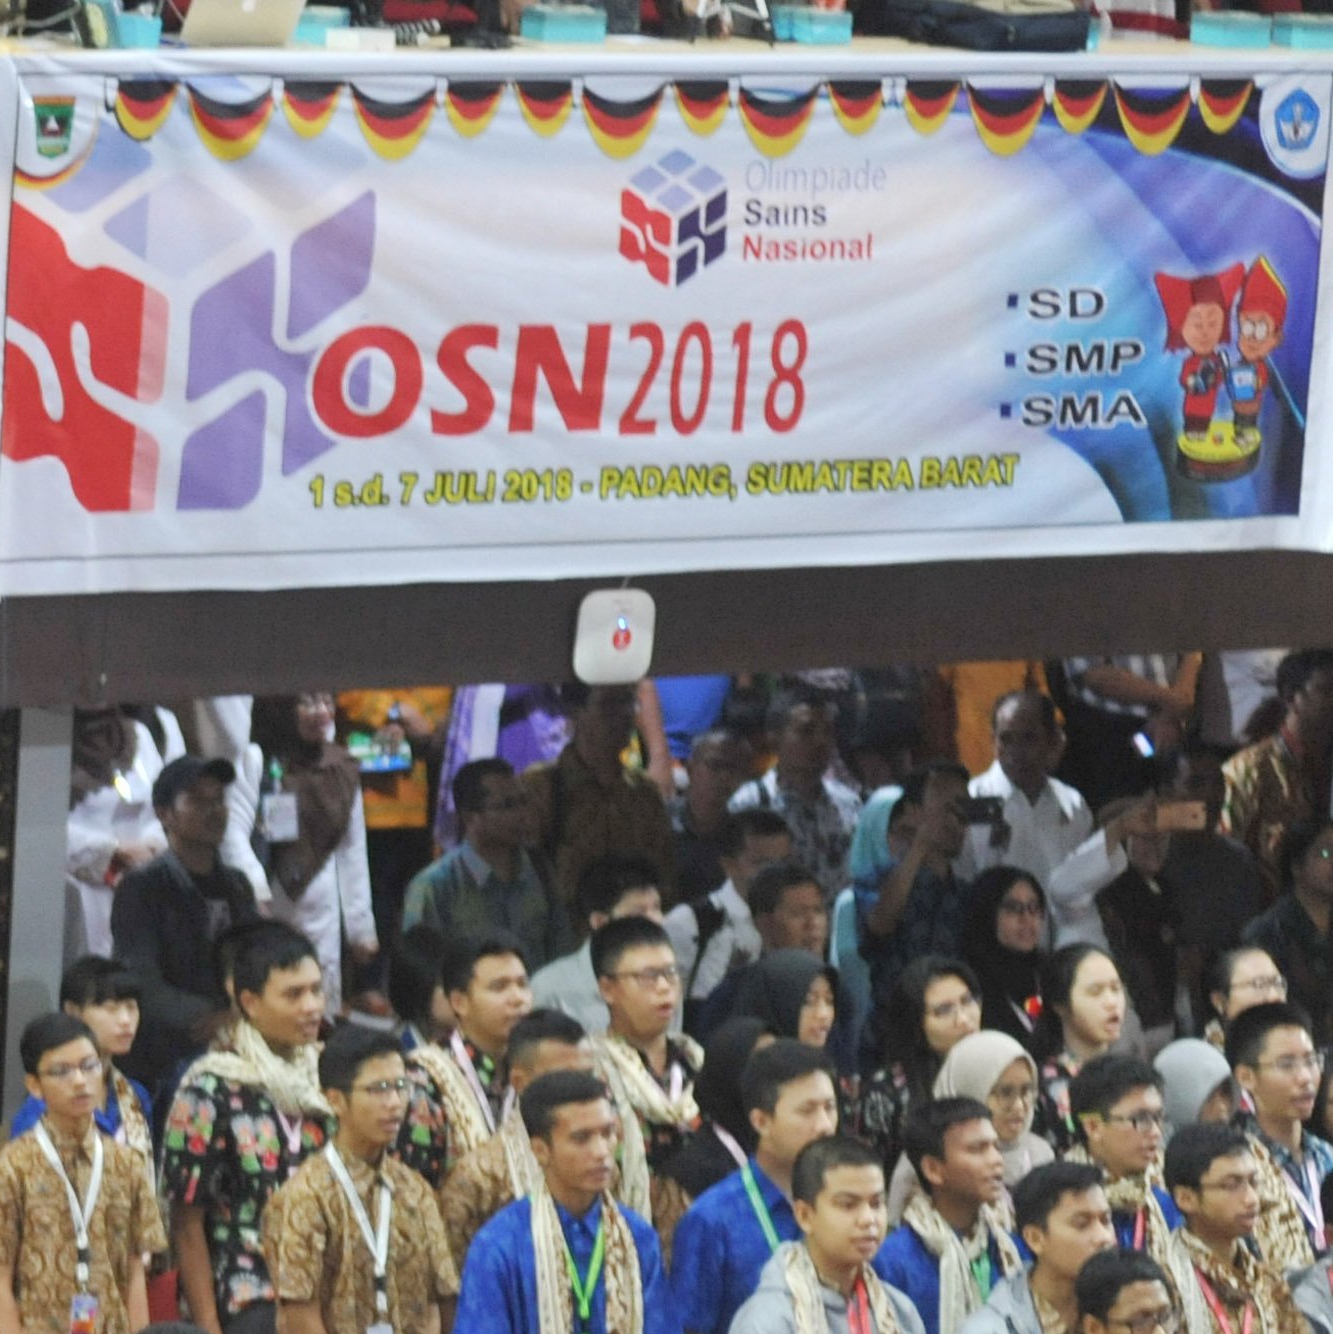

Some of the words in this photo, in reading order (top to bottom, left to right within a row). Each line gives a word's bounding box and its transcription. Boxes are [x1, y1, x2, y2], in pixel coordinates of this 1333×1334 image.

[744, 159, 887, 199] Olimpiade
[743, 199, 827, 227] Sains
[742, 232, 873, 261] Nasional
[1029, 289, 1104, 319] SD
[1027, 342, 1142, 375] SMP
[1022, 394, 1143, 428] SMA
[309, 474, 324, 508] 1
[399, 473, 418, 505] 7
[424, 471, 496, 504] JULI
[502, 468, 573, 501] 2018
[598, 463, 738, 499] PADANG,
[746, 458, 914, 494] SUMATERA
[920, 454, 1020, 488] BARAT
